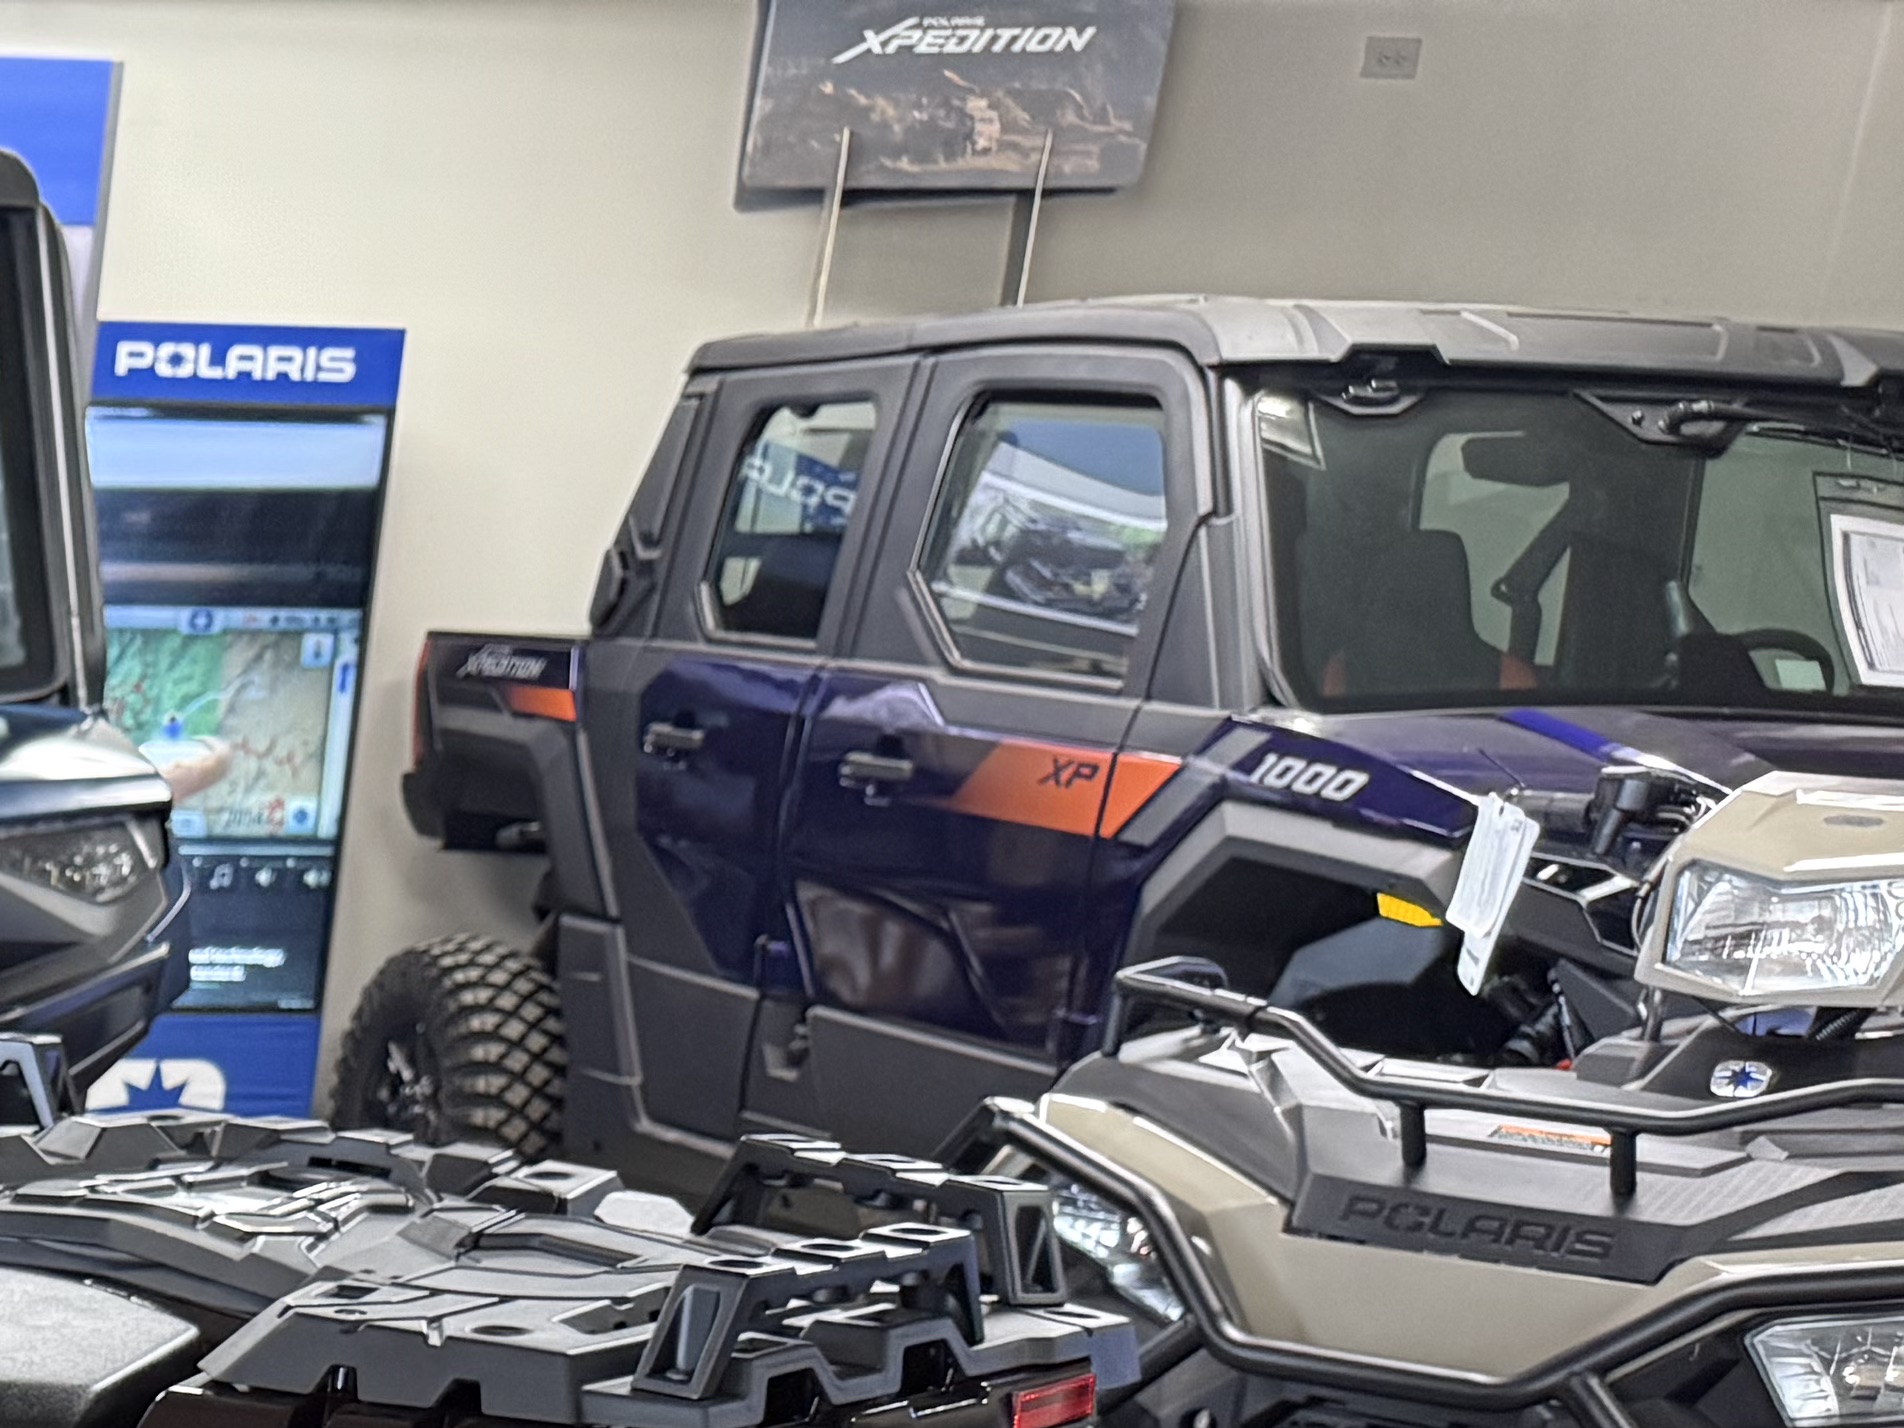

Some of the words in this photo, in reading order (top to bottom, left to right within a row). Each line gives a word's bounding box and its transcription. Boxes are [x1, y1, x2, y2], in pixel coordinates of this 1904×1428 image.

[831, 16, 1097, 64] XPEDITION
[114, 340, 357, 383] POLARIS
[1038, 757, 1100, 789] XP
[1248, 752, 1370, 802] 1000
[1338, 1194, 1617, 1261] POLARIS
